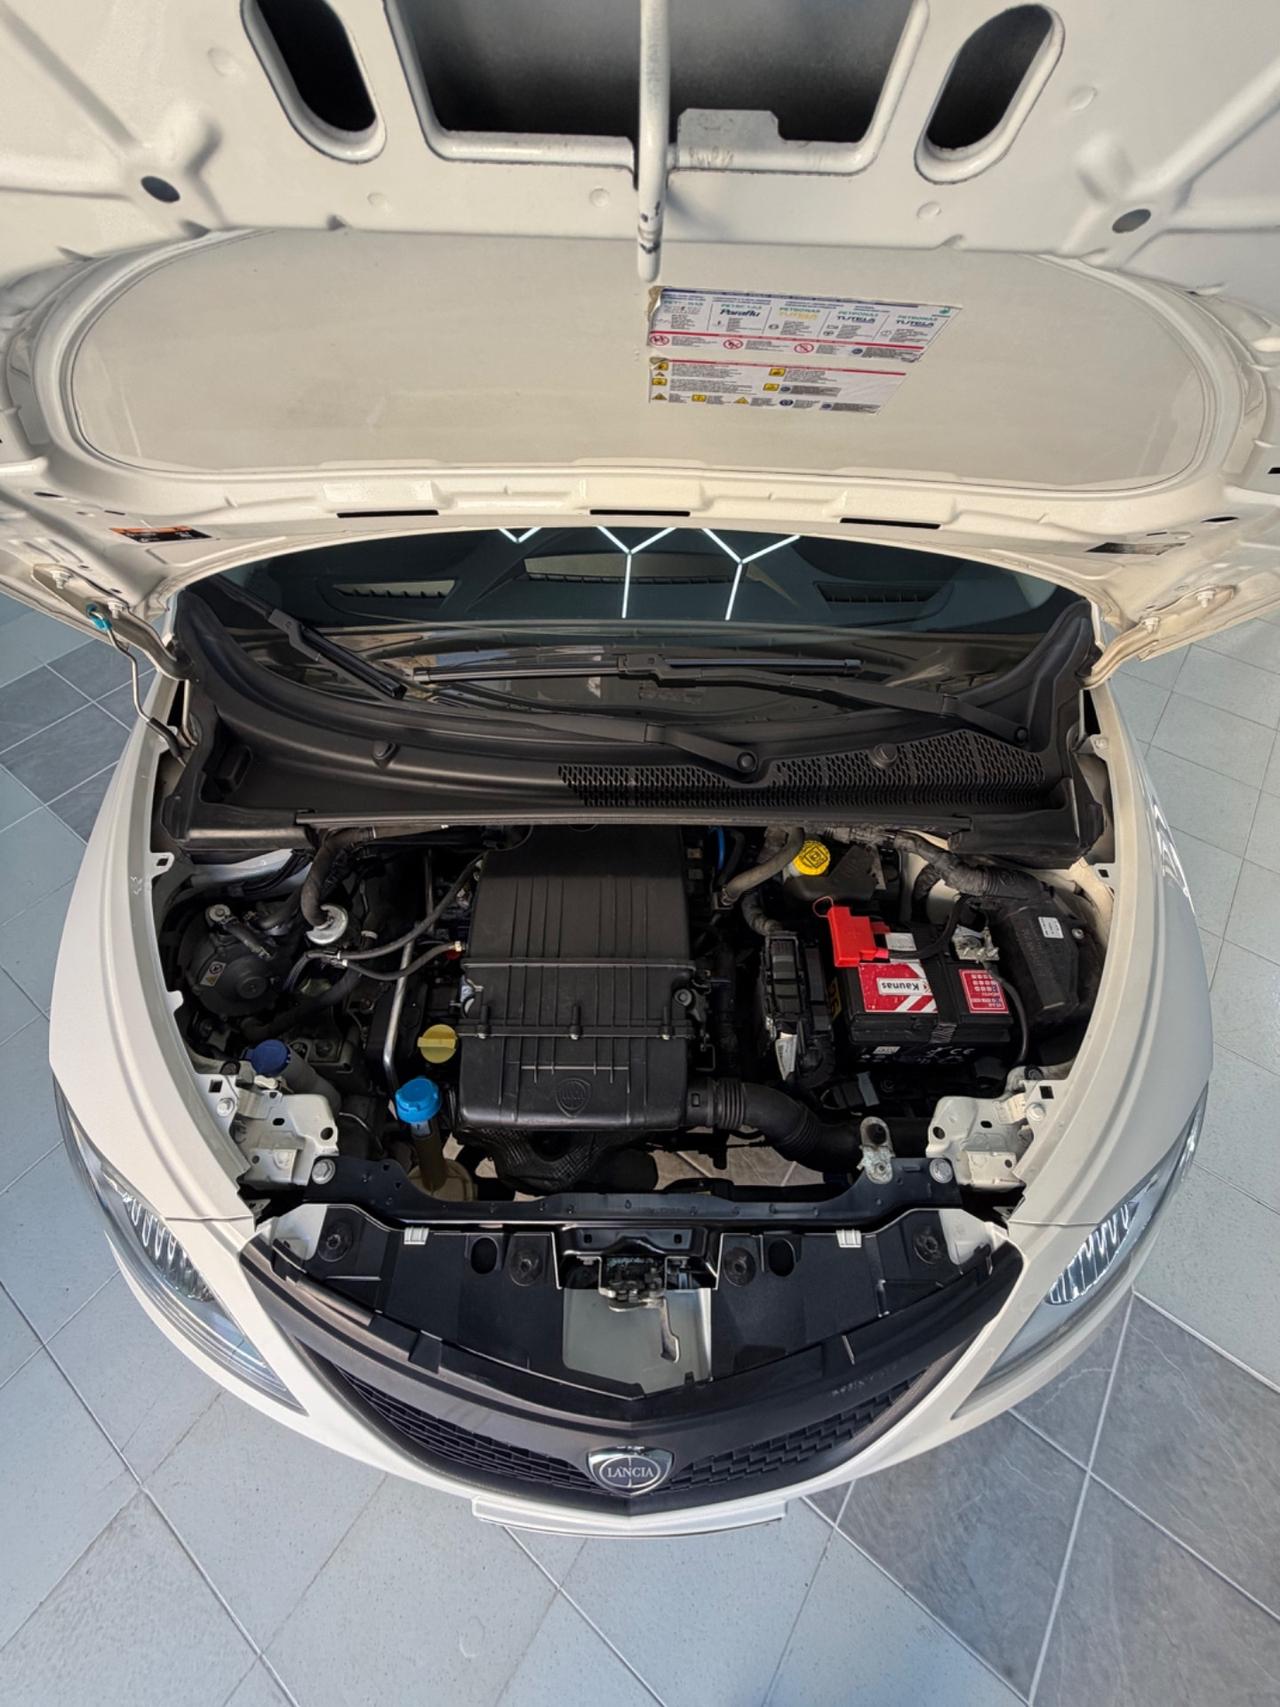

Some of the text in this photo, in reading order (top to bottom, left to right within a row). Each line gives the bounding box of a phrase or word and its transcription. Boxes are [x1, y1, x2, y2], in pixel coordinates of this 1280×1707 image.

[720, 308, 761, 317] Paraflu
[881, 982, 919, 990] Kaunas
[607, 1467, 654, 1478] LANCIA
